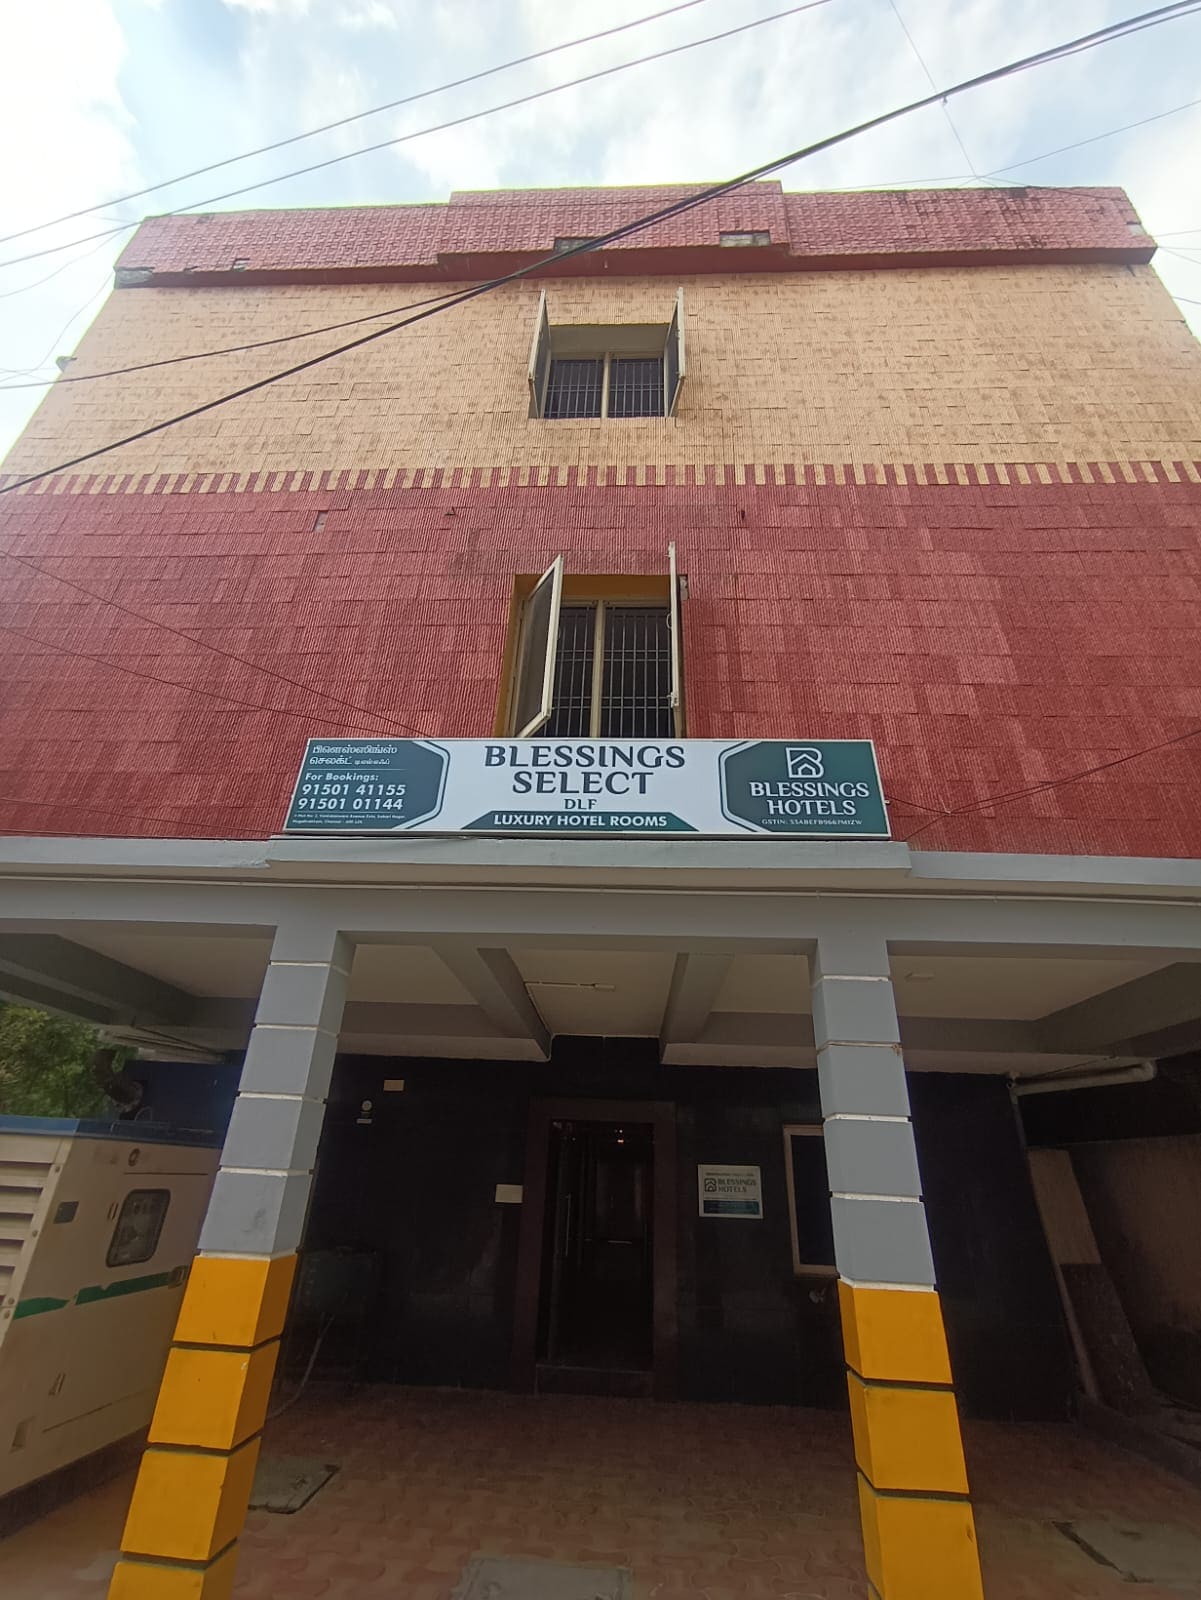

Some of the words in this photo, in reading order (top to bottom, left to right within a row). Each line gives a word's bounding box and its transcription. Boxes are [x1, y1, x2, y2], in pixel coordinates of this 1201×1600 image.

[309, 755, 352, 765] செலக்ட்
[484, 745, 685, 768] BLESSINGS
[305, 773, 323, 781] For
[326, 773, 379, 782] Bookings:
[512, 771, 654, 795] SELECT
[302, 784, 349, 795] 91501
[356, 784, 406, 796] 41155
[749, 782, 869, 797] BLESSINGS
[298, 798, 346, 809] 91501
[352, 799, 403, 810] 01144
[564, 798, 597, 810] DLF
[767, 799, 856, 815] HOTELS
[493, 815, 553, 826] LUXURY
[557, 816, 606, 827] HOTEL
[609, 816, 667, 827] ROOMS
